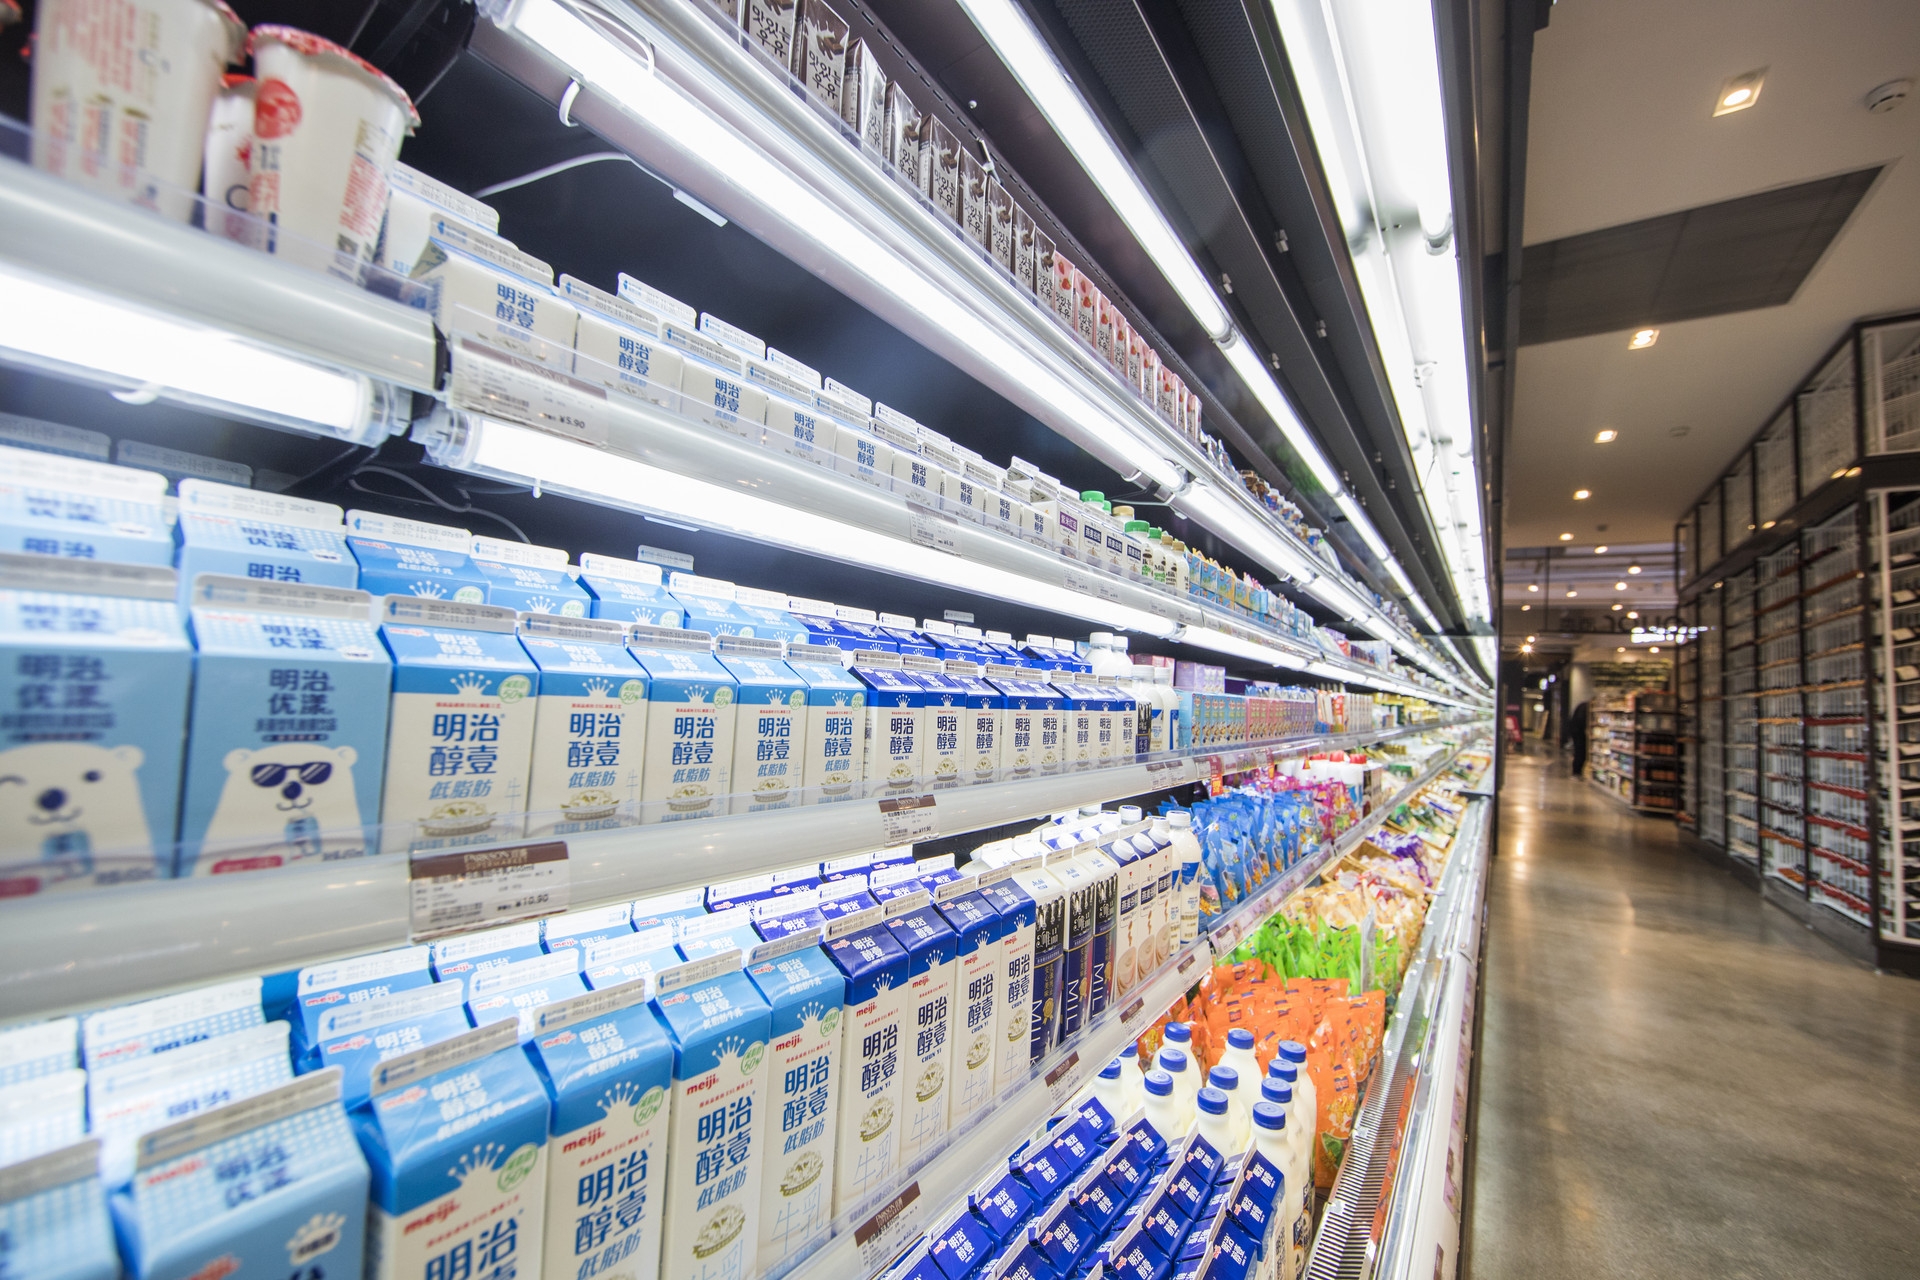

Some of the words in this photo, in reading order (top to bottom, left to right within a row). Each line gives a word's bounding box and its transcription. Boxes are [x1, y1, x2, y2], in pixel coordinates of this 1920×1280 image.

[497, 283, 536, 312] 明治
[496, 301, 535, 331] 醇壹
[619, 336, 650, 360] 明治
[619, 352, 650, 376] 醇壹
[715, 378, 740, 399] 明治
[714, 392, 739, 414] 醇壹
[794, 411, 815, 430] 明治
[794, 425, 815, 444] 醇壹
[857, 439, 875, 455] 明治
[857, 451, 875, 468] 醇壹
[911, 461, 926, 477] 明治
[269, 669, 332, 691] 明治
[432, 713, 500, 742] 明治
[570, 713, 621, 738] 明治
[674, 717, 715, 739] 明治
[758, 717, 790, 737] 明治
[825, 718, 852, 736] 明治
[890, 717, 914, 735] 明治
[937, 716, 957, 732] 明治
[977, 717, 993, 733] 明治
[1015, 717, 1030, 732] 明治
[1043, 717, 1057, 731] 明治
[757, 740, 790, 761] 醇壹
[824, 738, 852, 757] 醇壹
[890, 737, 914, 755] 醇壹
[936, 733, 957, 750] 醇壹
[429, 745, 499, 776] 醇壹
[568, 741, 620, 768] 醇壹
[672, 741, 714, 766] 醇壹
[672, 767, 710, 784] 低脂肪
[757, 763, 787, 777] 低脂肪
[825, 759, 850, 772] 低脂肪
[429, 779, 495, 800] 低脂肪
[568, 770, 617, 788] 低脂肪
[553, 938, 578, 949] meiji
[852, 935, 876, 950] 明治
[442, 963, 474, 975] meiji
[476, 957, 509, 972] 明治
[777, 958, 805, 974] 明治
[1008, 953, 1030, 978] 明治
[912, 976, 930, 989] meiji
[968, 972, 994, 1002] 明治
[1008, 974, 1030, 1004] 醇壹
[663, 992, 690, 1007] meiji
[692, 986, 724, 1004] 明治
[856, 1002, 876, 1018] meiji
[918, 996, 948, 1028] 明治
[967, 994, 993, 1029] 醇壹
[375, 1026, 421, 1049] 明治
[580, 1022, 618, 1045] 明治
[917, 1020, 947, 1056] 醇壹
[971, 1024, 983, 1035] CHUN
[775, 1034, 801, 1052] meiji
[863, 1024, 898, 1060] 明治
[921, 1052, 935, 1063] CHUN
[785, 1055, 830, 1097] 明治
[862, 1050, 897, 1092] 醇壹
[686, 1073, 718, 1096] meiji
[867, 1086, 882, 1099] CHUN
[884, 1082, 891, 1091] YI
[783, 1084, 828, 1133] 醇壹
[697, 1096, 752, 1145] 明治
[562, 1127, 605, 1154] meiji
[783, 1117, 825, 1155] 低脂肪
[695, 1128, 751, 1187] 醇壹
[577, 1149, 649, 1208] 明治
[697, 1166, 748, 1212] 低脂肪
[992, 1188, 1010, 1208] 明治
[403, 1198, 460, 1236] meiji
[575, 1184, 647, 1257] 醇壹
[949, 1228, 967, 1249] 明治
[1127, 1246, 1145, 1266] 明治
